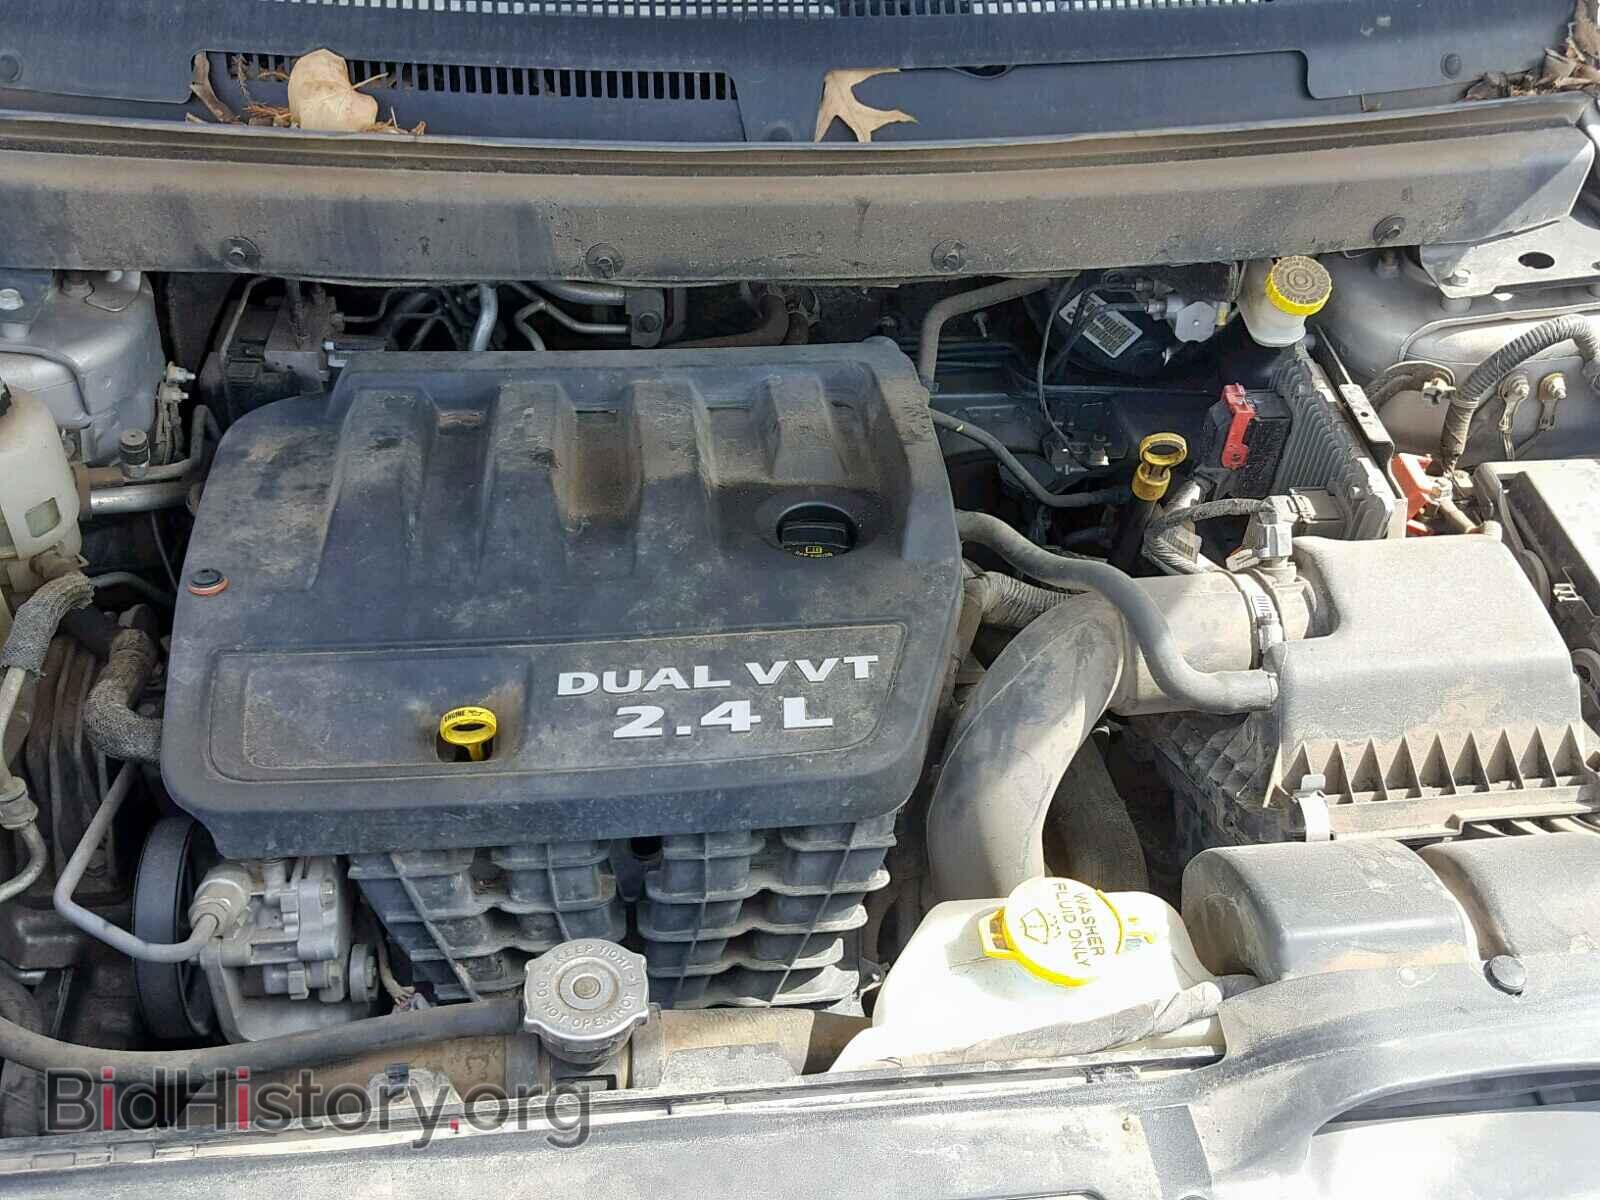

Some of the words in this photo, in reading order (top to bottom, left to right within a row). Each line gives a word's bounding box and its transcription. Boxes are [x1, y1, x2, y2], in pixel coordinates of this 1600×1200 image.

[557, 664, 732, 696] DUAL
[744, 655, 879, 686] VVT
[444, 710, 465, 722] ENGINE
[1053, 883, 1077, 923] FLUID
[1067, 929, 1091, 968] ONLY
[1074, 891, 1105, 957] WASHER
[536, 980, 549, 999] DO
[541, 1002, 569, 1023] NOT
